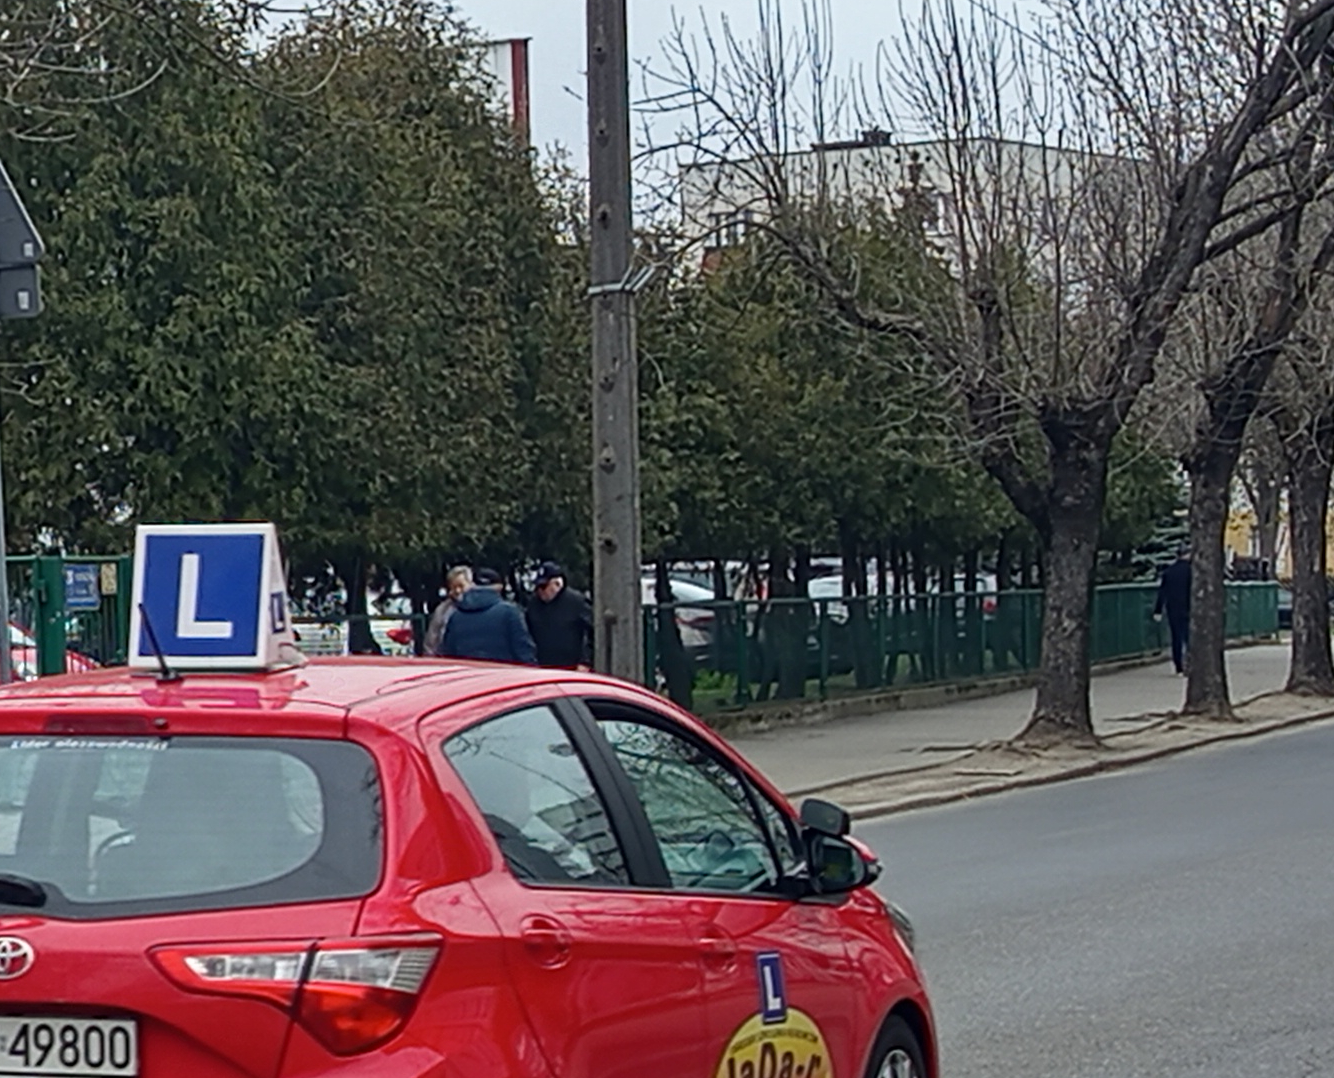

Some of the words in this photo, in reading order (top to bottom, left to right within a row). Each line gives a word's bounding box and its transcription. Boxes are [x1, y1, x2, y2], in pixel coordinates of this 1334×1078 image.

[178, 553, 233, 638] L
[273, 598, 283, 629] L
[763, 965, 782, 1010] L
[8, 1023, 131, 1069] 49800
